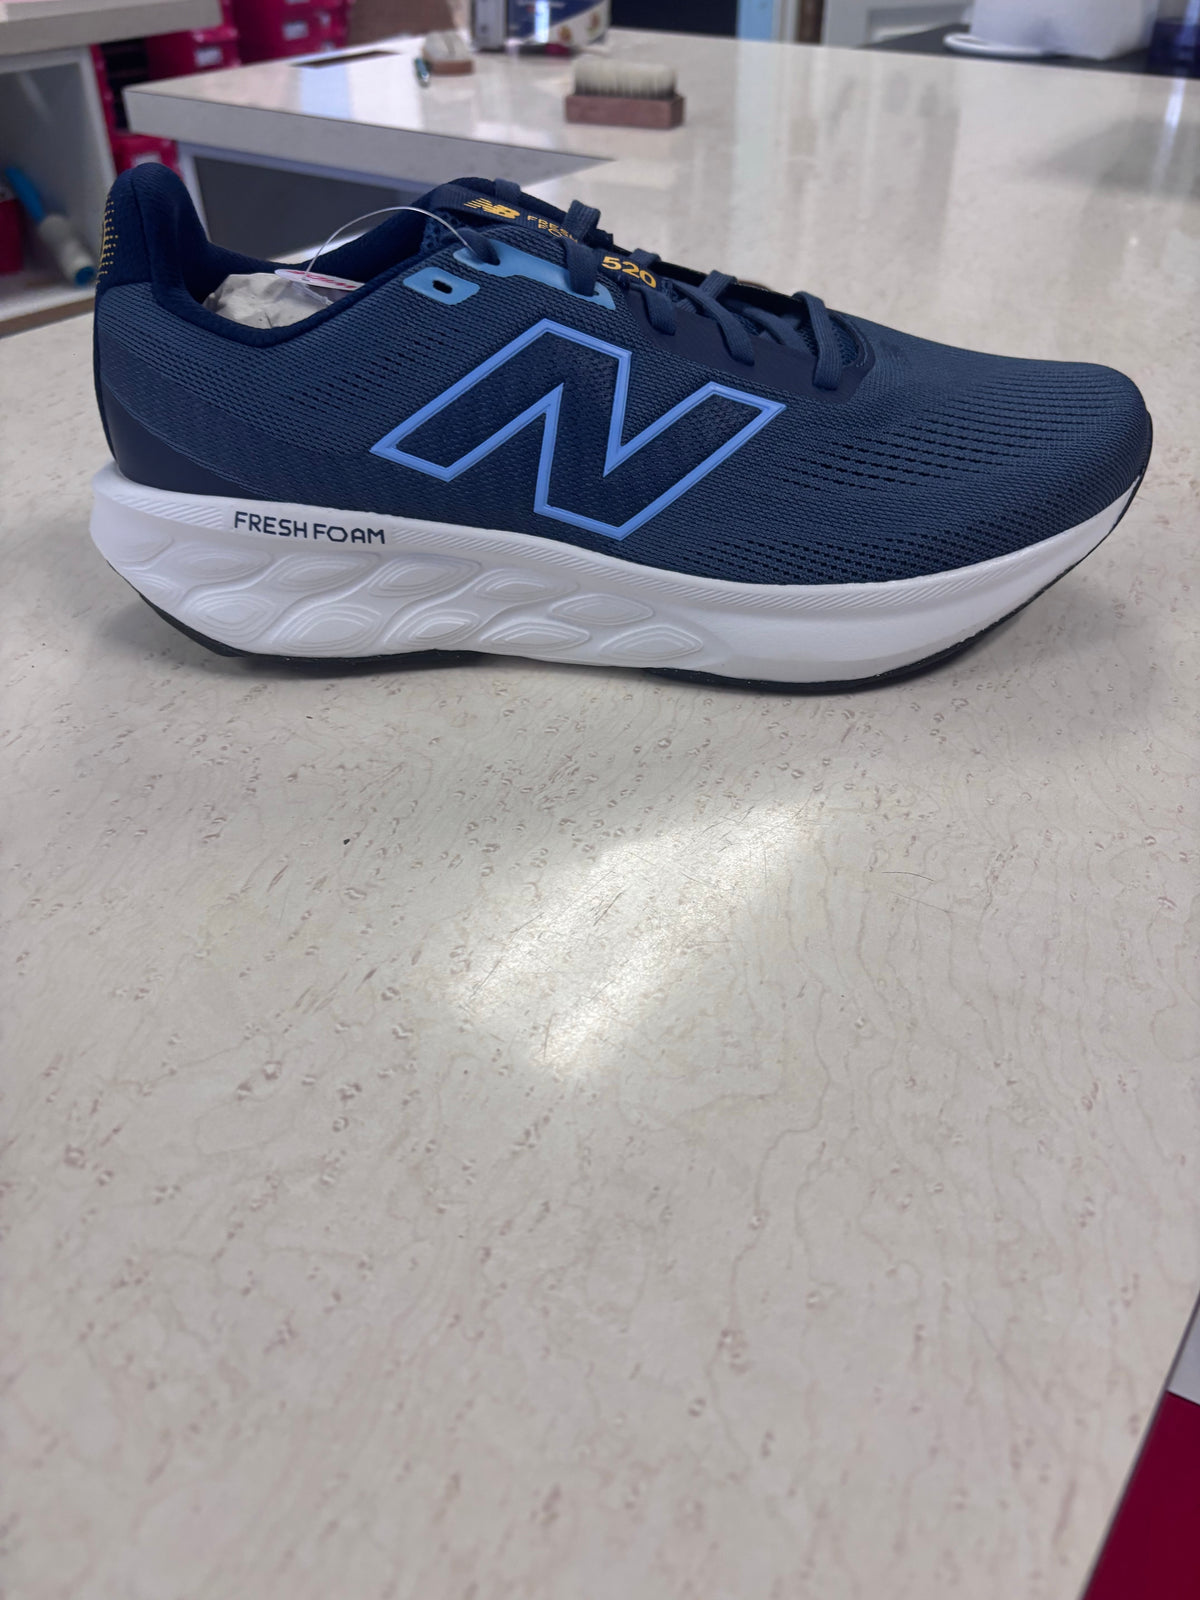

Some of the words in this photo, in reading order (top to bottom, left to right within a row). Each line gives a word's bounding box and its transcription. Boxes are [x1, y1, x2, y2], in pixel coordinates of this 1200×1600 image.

[601, 256, 657, 288] 520
[234, 511, 308, 538] FRESH
[313, 523, 385, 544] FOAM
